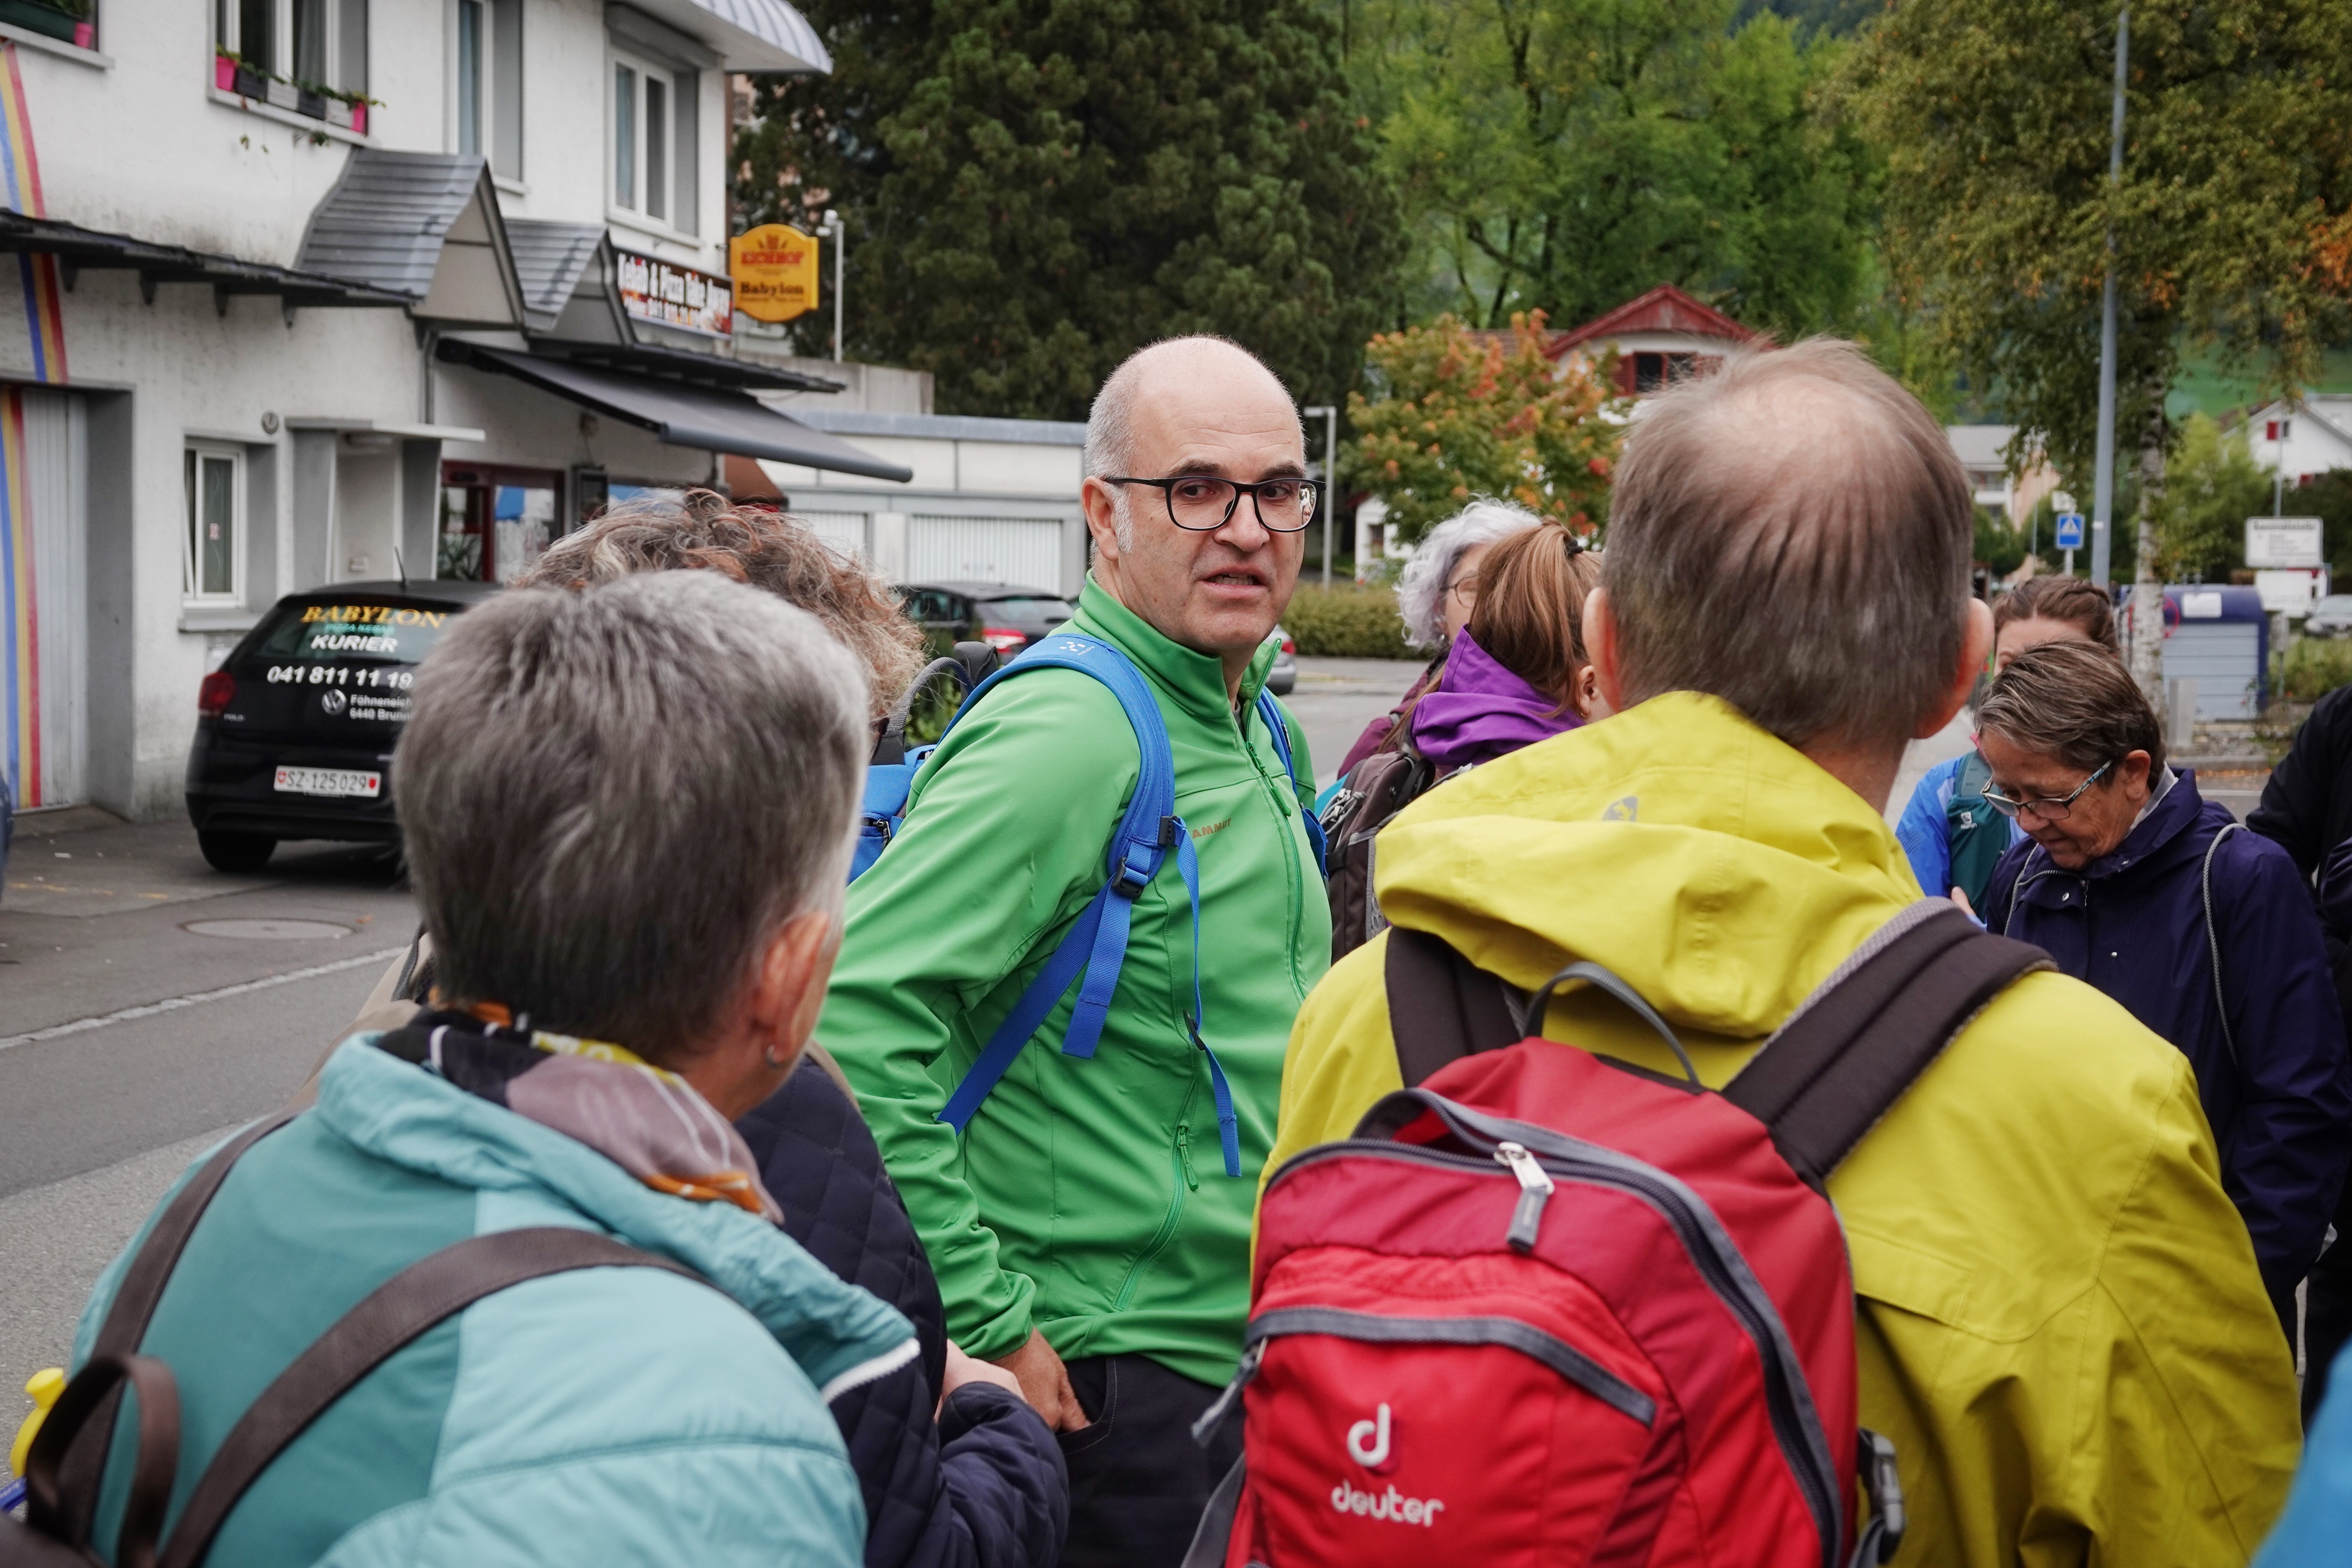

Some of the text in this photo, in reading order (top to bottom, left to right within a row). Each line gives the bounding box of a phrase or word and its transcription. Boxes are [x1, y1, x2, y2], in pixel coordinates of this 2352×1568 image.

[618, 252, 648, 295] Kebab
[650, 262, 658, 297] &
[659, 264, 684, 303] Pizza
[685, 270, 705, 309] Take
[741, 282, 804, 296] Babylon
[301, 606, 446, 629] BABYLON
[325, 624, 395, 635] PIZZA KEBAB
[311, 634, 399, 653] KURIER
[267, 666, 306, 683] 041
[309, 667, 349, 685] 811
[355, 669, 381, 687] 11
[349, 707, 413, 722] 6440 Brunn
[287, 771, 305, 787] SZ
[1192, 818, 1232, 839] AMMUT
[1331, 1479, 1445, 1527] deuter
